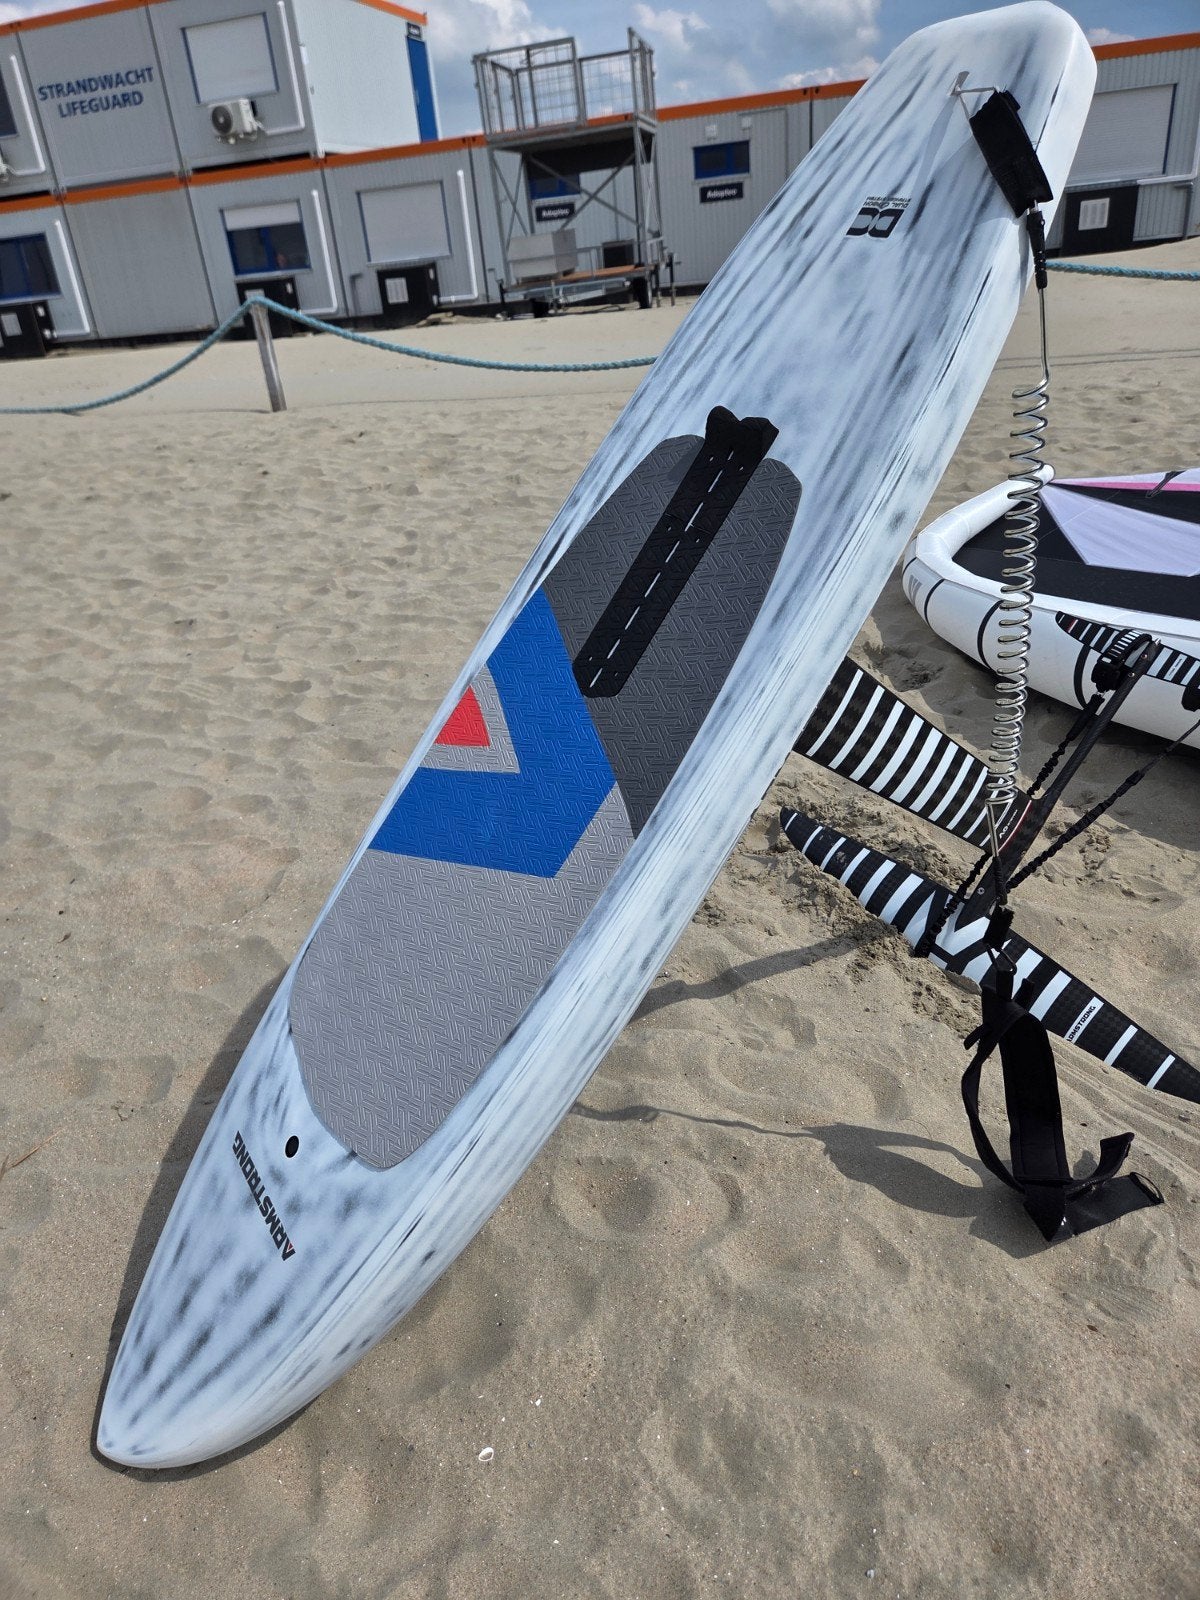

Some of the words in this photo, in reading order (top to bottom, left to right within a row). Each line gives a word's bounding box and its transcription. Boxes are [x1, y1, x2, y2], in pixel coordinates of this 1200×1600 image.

[37, 67, 154, 101] STRANDWACHT
[57, 90, 144, 118] LIFEGUARD
[232, 1130, 296, 1261] ARMSTRONG
